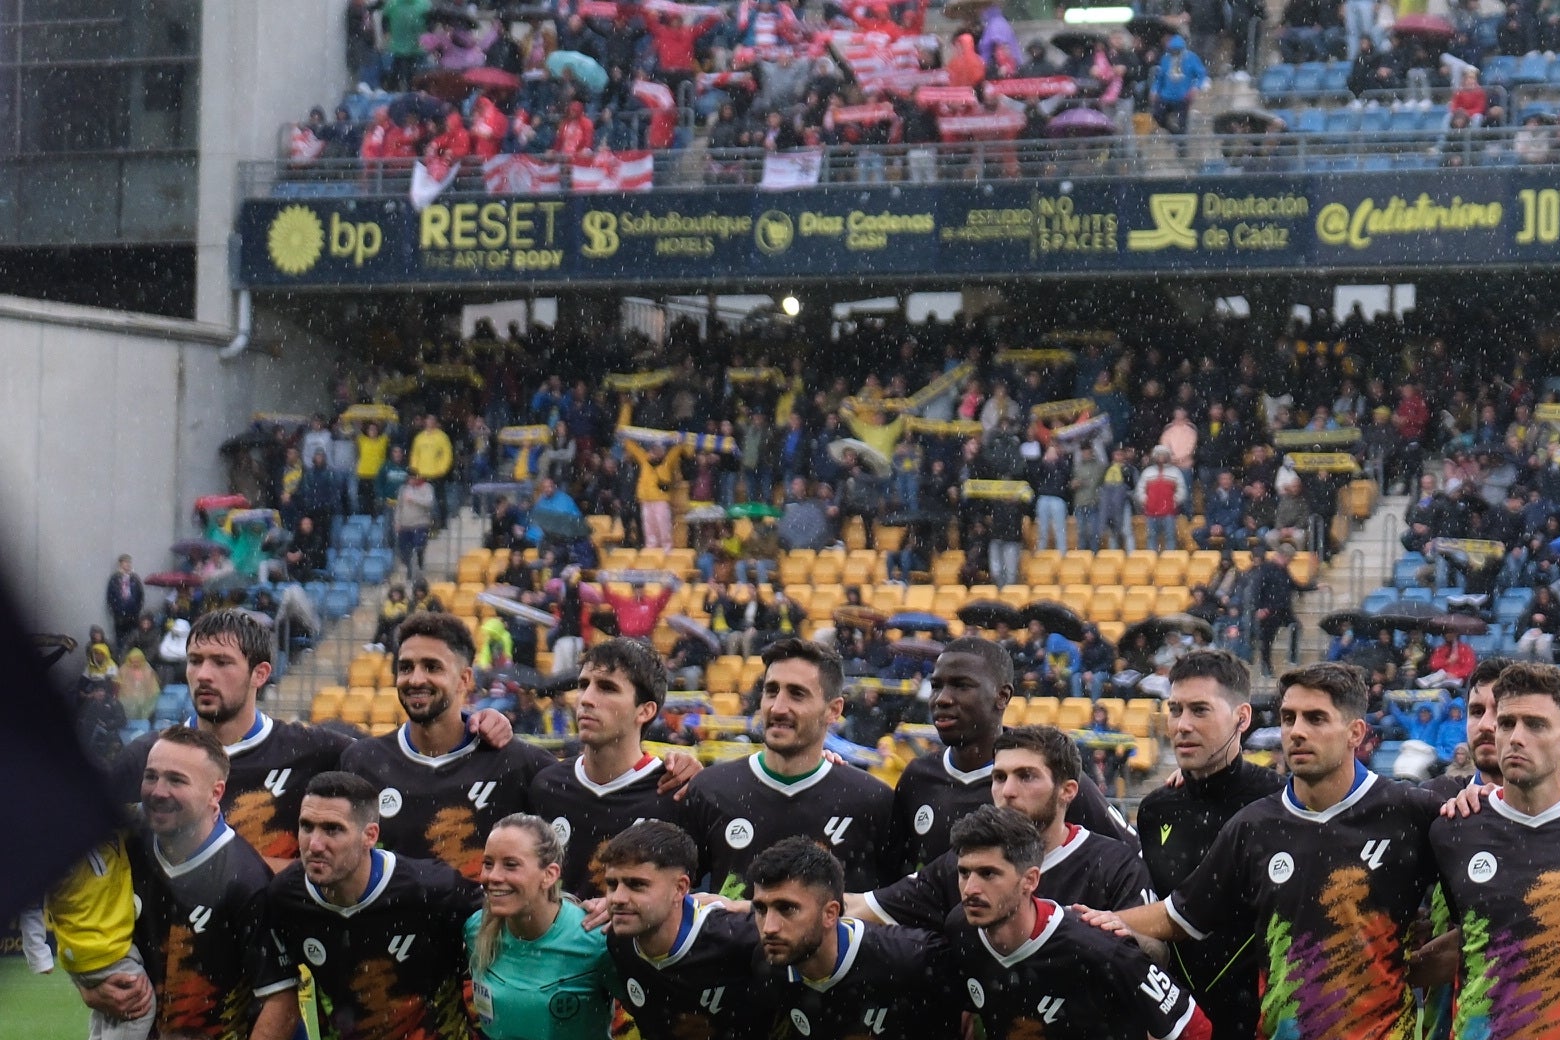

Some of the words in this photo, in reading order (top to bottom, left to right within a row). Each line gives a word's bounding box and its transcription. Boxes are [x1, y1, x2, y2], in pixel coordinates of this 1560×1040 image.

[1038, 196, 1074, 217] NO
[1203, 193, 1309, 219] Diputación
[420, 202, 565, 249] RESET
[1038, 213, 1118, 234] LIMITS
[1203, 226, 1230, 248] de
[1234, 223, 1290, 249] Cádiz
[330, 211, 383, 266] bp
[513, 249, 564, 270] BODY
[472, 983, 490, 999] FIFA
[1140, 964, 1171, 1003] VS
